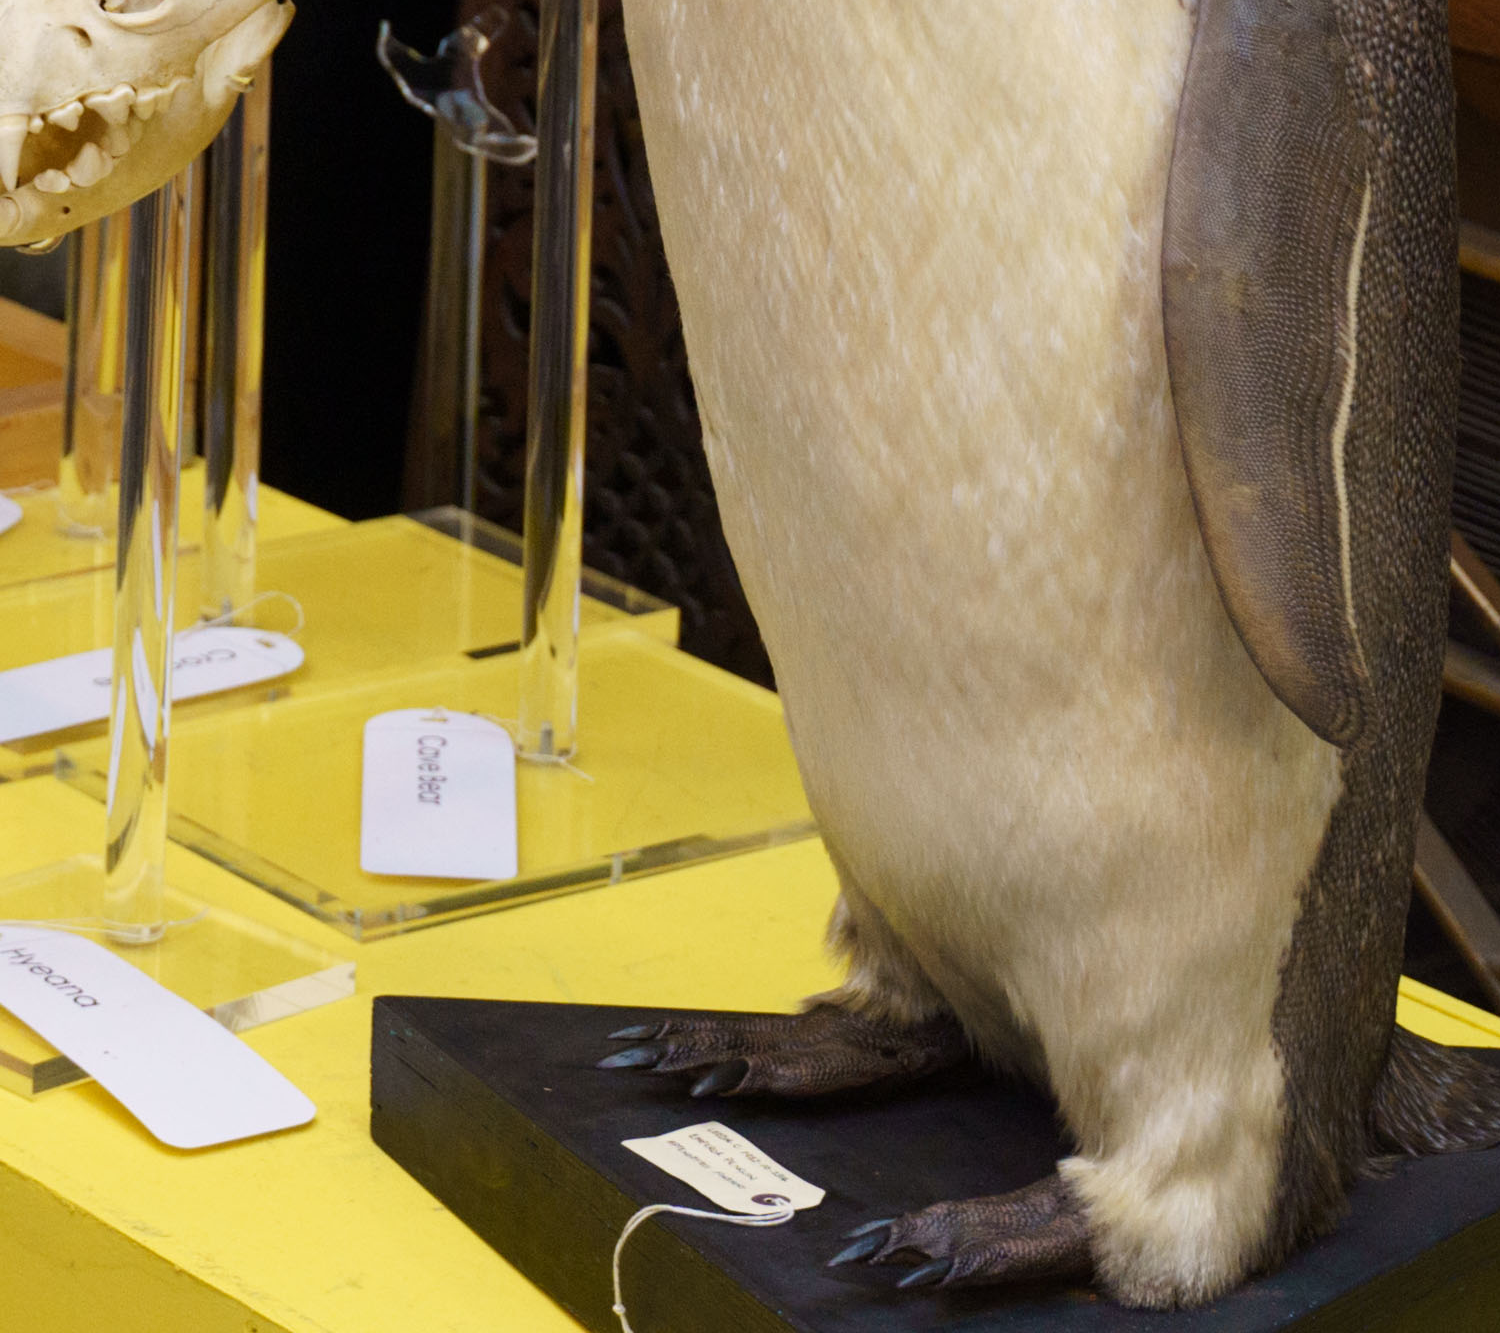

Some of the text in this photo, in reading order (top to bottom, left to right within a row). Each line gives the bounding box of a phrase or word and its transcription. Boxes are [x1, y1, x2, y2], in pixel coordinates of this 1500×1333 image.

[417, 735, 447, 805] Cave Bear
[0, 947, 100, 1008] Hyeana
